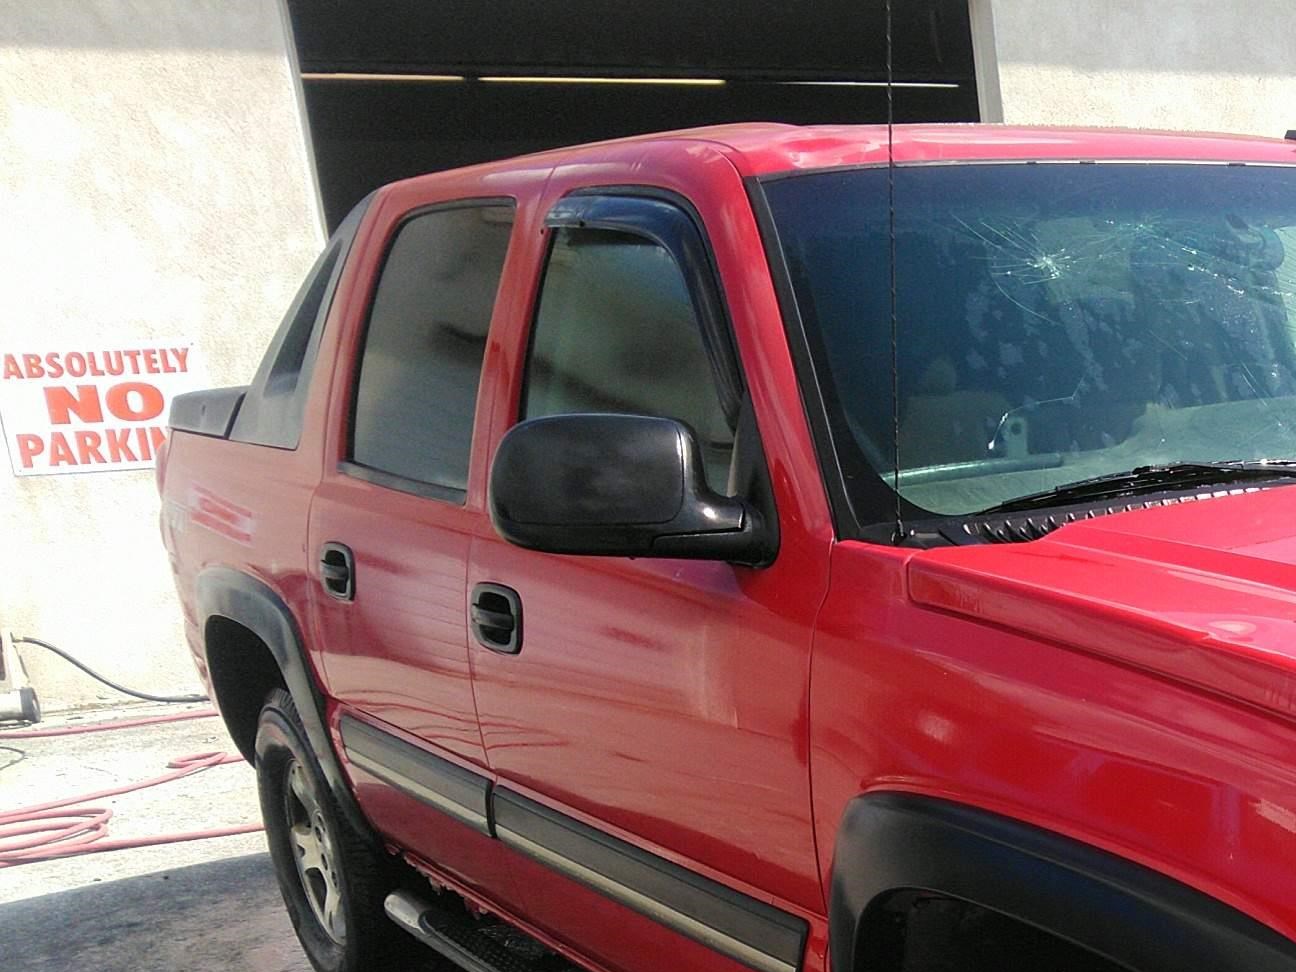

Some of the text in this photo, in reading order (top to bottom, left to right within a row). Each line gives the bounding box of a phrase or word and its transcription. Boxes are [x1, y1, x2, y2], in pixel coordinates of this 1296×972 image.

[3, 347, 189, 379] ABSOLUTELY
[43, 381, 165, 425] NO
[15, 426, 167, 468] PARKIN
